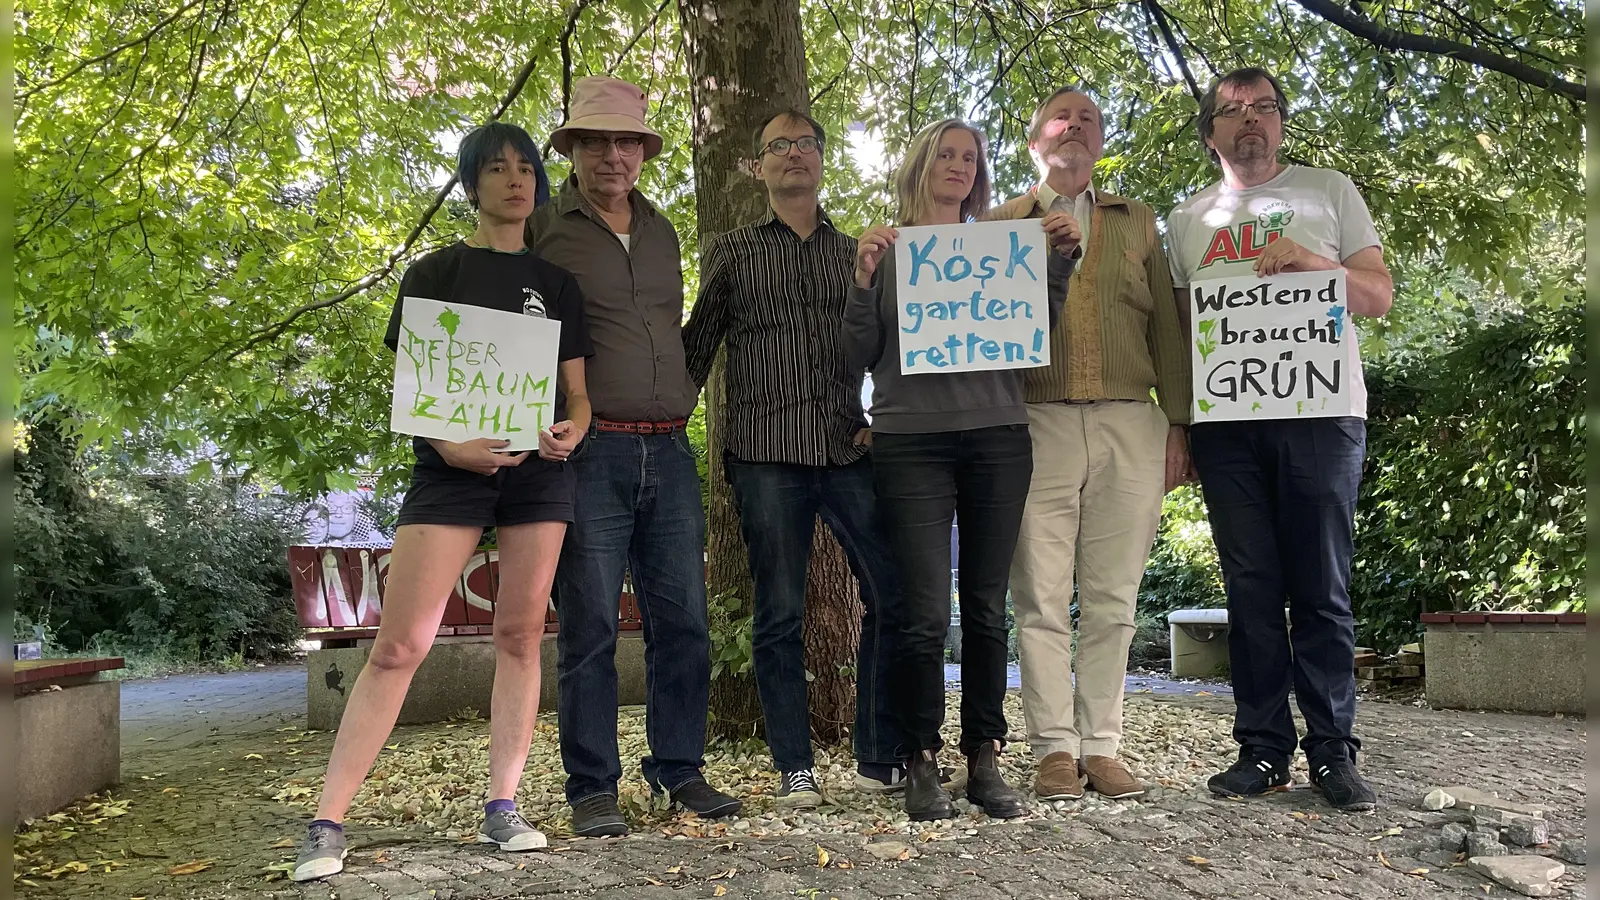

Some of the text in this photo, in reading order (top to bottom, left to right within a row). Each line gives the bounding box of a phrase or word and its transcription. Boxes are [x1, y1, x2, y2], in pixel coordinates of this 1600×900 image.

[901, 291, 1033, 333] garten
[1194, 278, 1338, 314] Westend
[403, 331, 501, 371] JEDER
[906, 327, 1044, 367] retten!
[1220, 316, 1341, 346] braucht
[447, 367, 549, 402] BAUM
[1206, 351, 1341, 402] GRÜN
[410, 392, 549, 435] ZÄHLT
